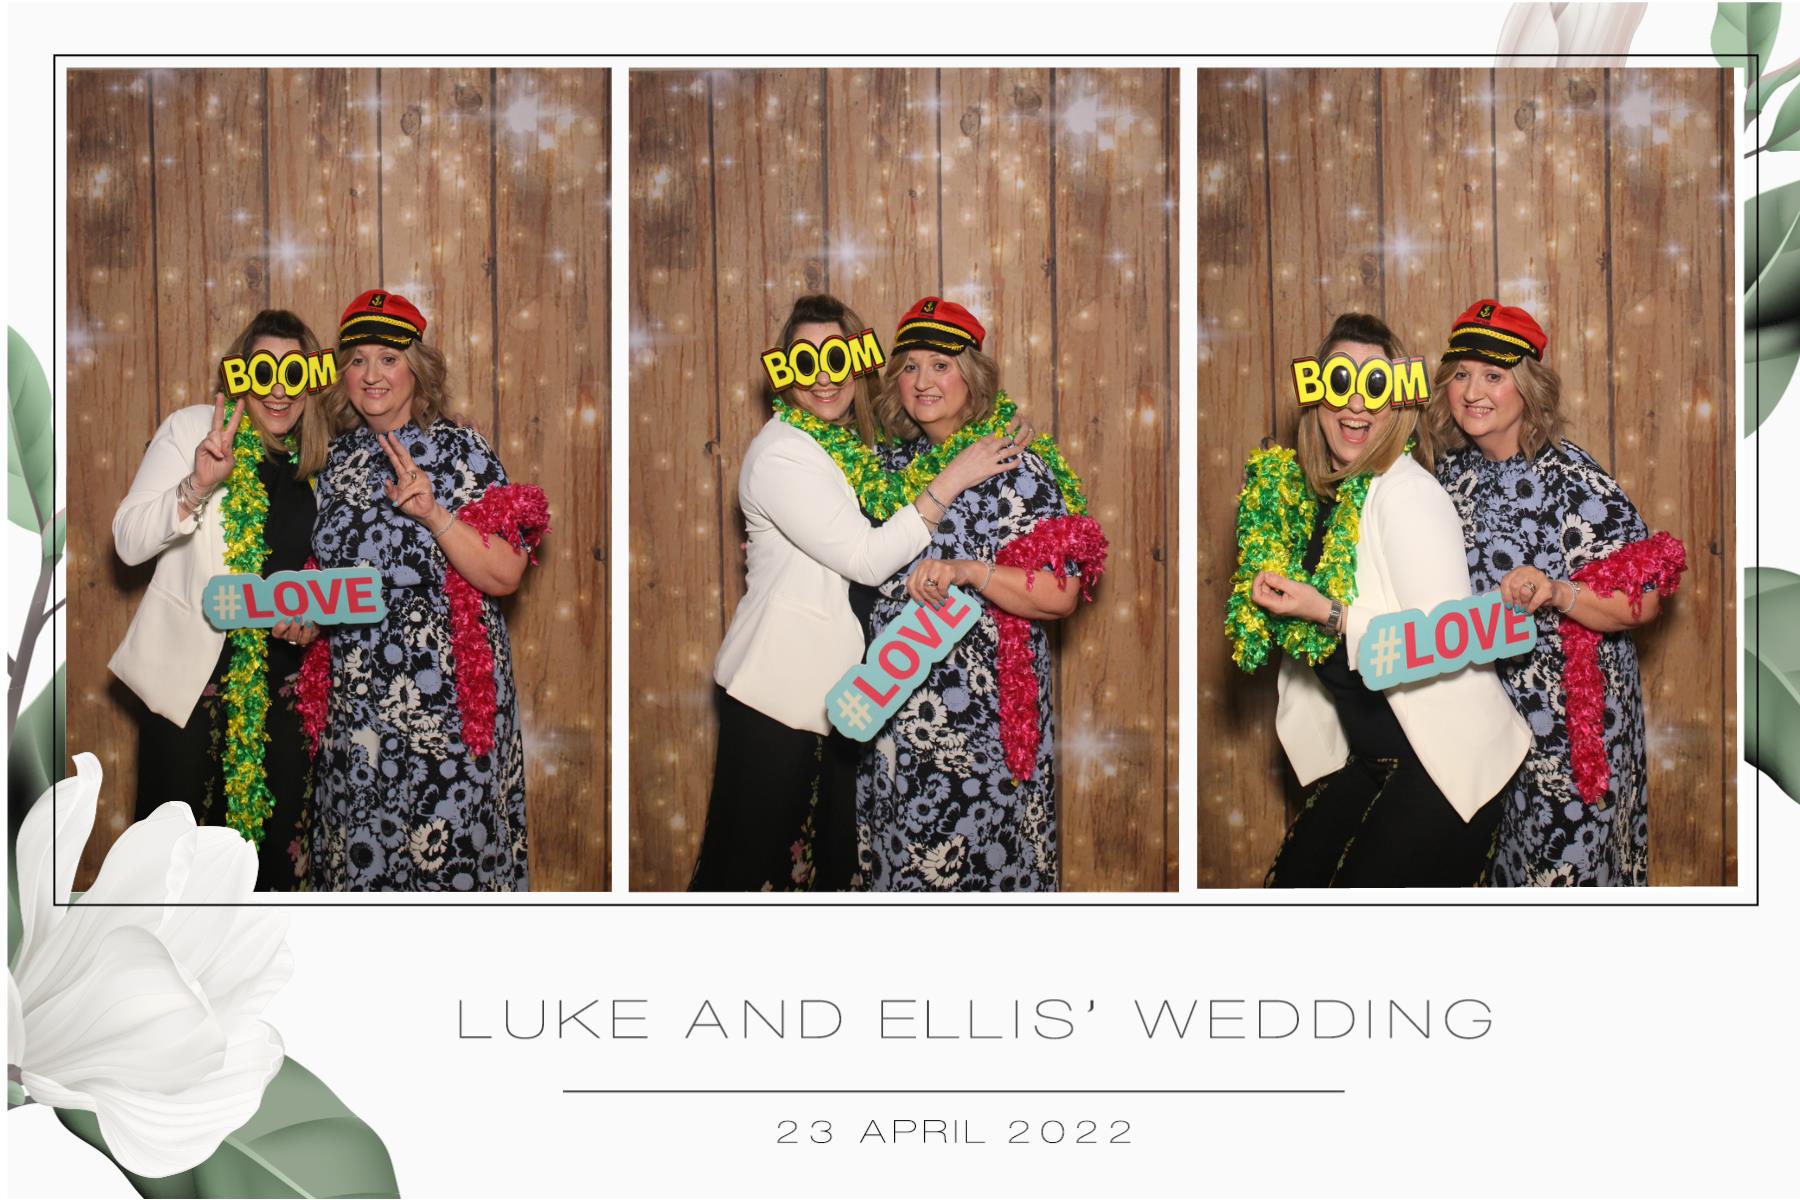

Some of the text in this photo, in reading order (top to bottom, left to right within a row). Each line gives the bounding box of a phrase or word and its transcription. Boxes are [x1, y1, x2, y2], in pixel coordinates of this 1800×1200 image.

[222, 350, 338, 398] BOOM
[762, 331, 885, 390] BOOM
[1295, 354, 1430, 411] BOOM
[213, 577, 376, 620] #LOVE
[1370, 603, 1530, 676] #LOVE
